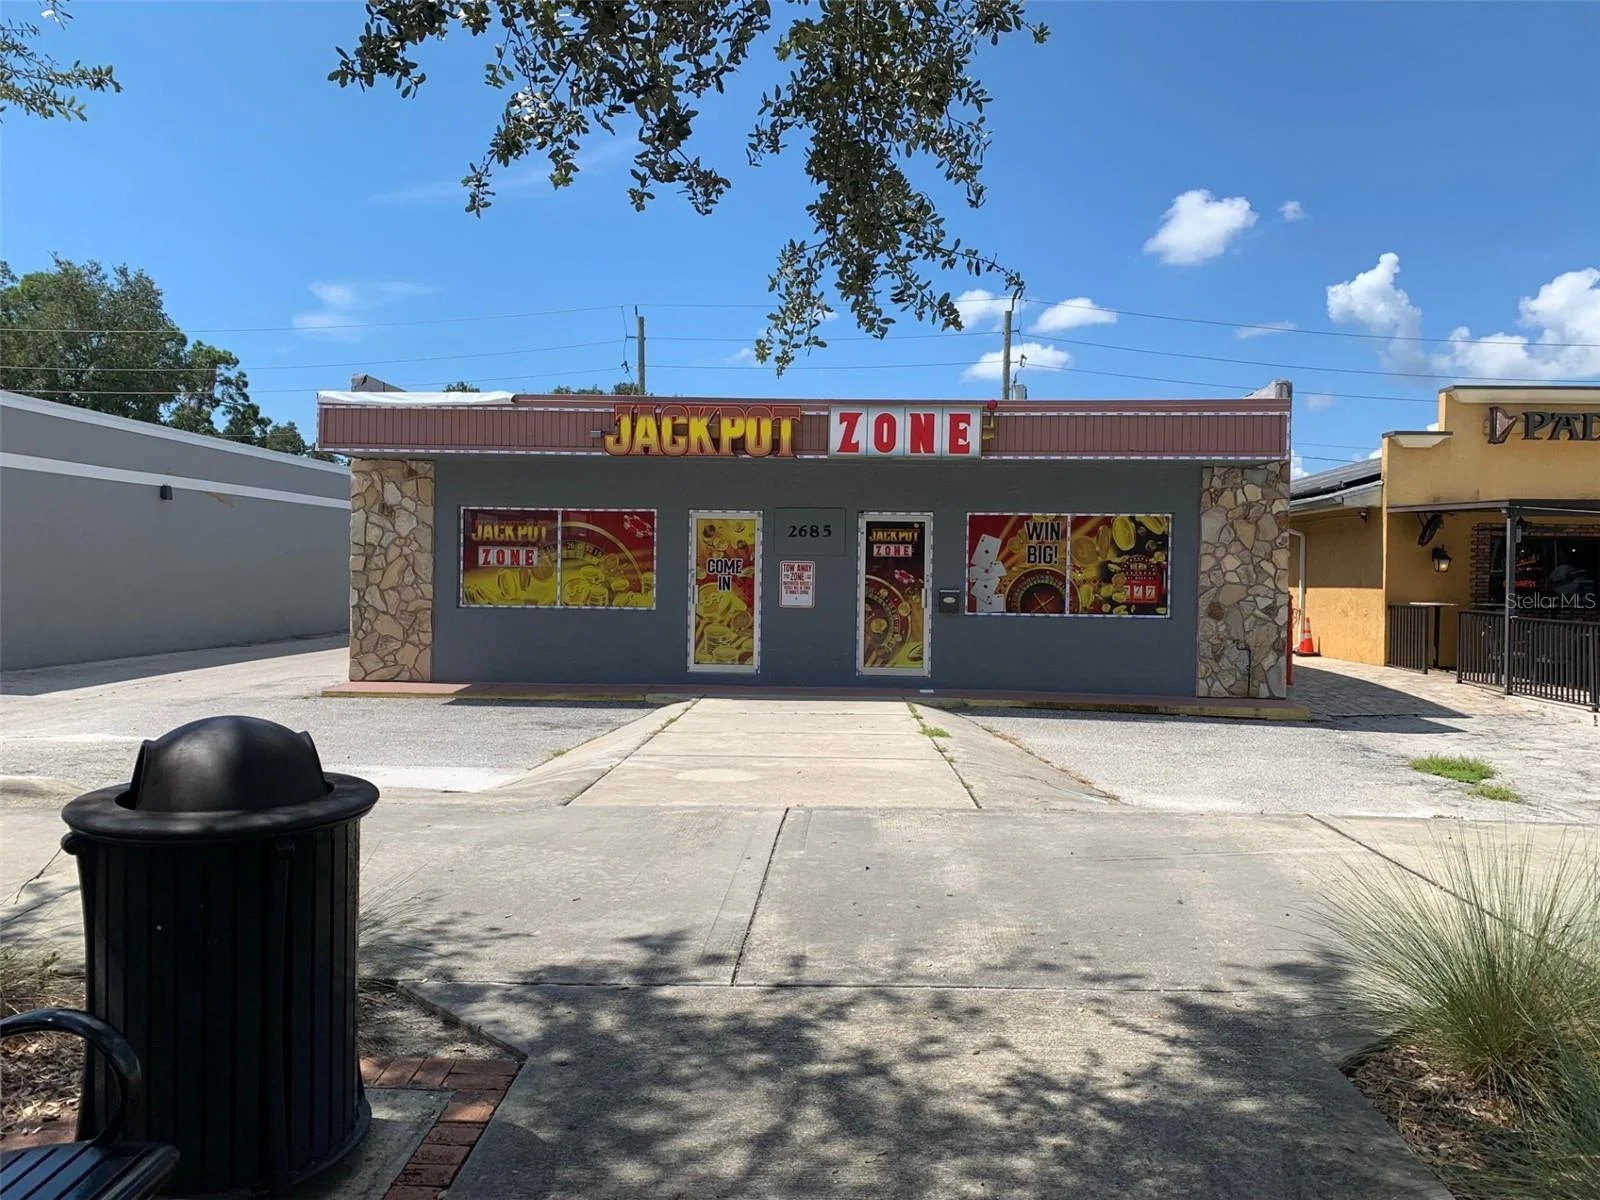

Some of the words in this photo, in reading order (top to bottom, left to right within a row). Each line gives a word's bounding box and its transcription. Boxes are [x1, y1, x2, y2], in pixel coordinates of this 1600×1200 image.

[604, 403, 801, 457] JACKPOT
[838, 412, 971, 455] ZONE
[471, 520, 552, 542] JACKPOT
[788, 524, 832, 538] 2685
[869, 528, 919, 542] JACKPOT
[1026, 521, 1061, 541] WIN
[482, 548, 535, 567] ZONE
[875, 545, 910, 556] ZONE
[1027, 545, 1058, 564] BIG!
[707, 559, 743, 574] COME
[783, 563, 796, 573] TOW
[797, 563, 812, 573] AWAY
[718, 575, 731, 591] IN
[790, 572, 805, 581] ZONE
